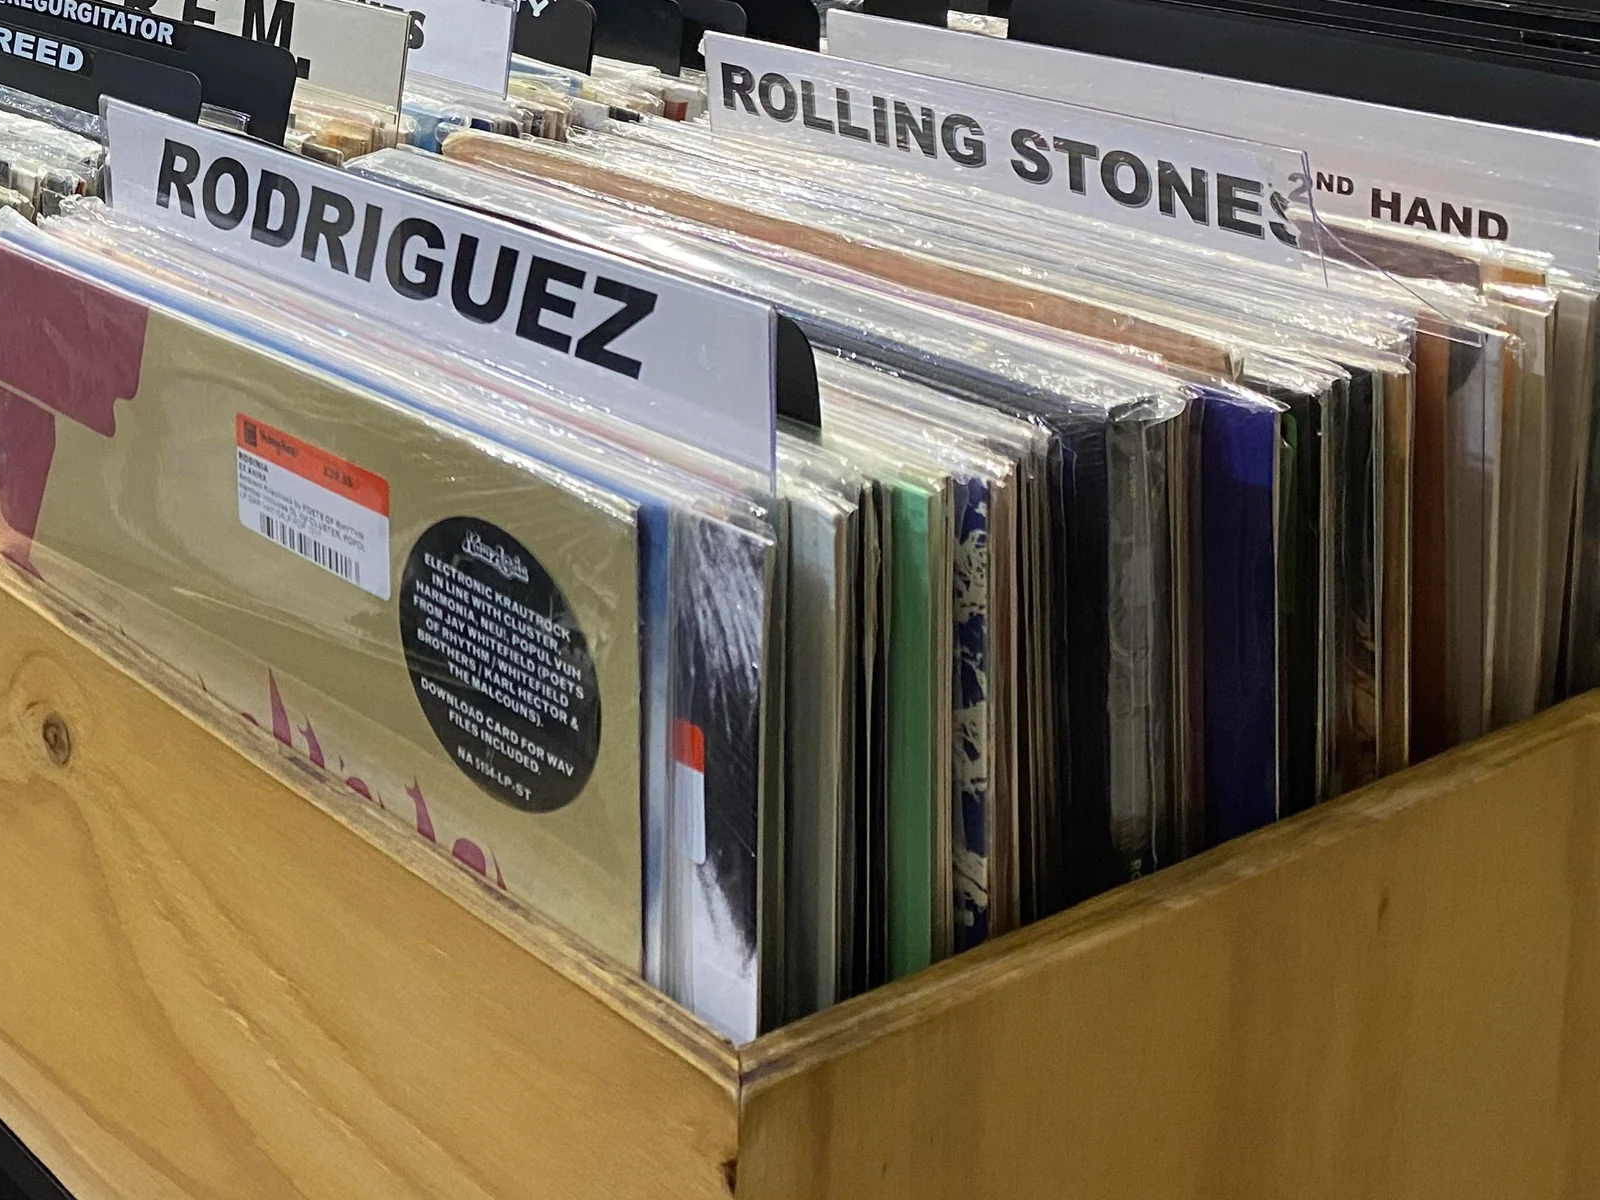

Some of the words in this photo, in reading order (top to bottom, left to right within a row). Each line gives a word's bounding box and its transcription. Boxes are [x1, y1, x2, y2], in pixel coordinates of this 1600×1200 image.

[721, 62, 987, 169] ROLLING
[1010, 129, 1300, 248] STONES
[157, 138, 658, 380] RODRIGUEZ
[1371, 188, 1509, 243] HAND
[425, 553, 493, 599] ELECTRONIC
[495, 592, 572, 642] KRAUTROCK
[432, 574, 444, 589] IN
[445, 581, 470, 604] LINE
[472, 596, 501, 621] WITH
[414, 595, 443, 620] FROM
[444, 614, 466, 636] JAY
[467, 627, 535, 673] WHITEFIELD
[537, 666, 584, 700] (POETS
[417, 628, 477, 675] BROTHERS
[484, 667, 516, 695] KARL
[518, 687, 568, 725] HECTOR
[570, 716, 579, 732] &
[425, 618, 447, 639] OF
[449, 630, 490, 663] RHYTHM
[498, 659, 569, 708] WHITEFIELD
[448, 661, 470, 684] THE
[512, 634, 551, 664] POPUL
[555, 660, 581, 680] VUH
[421, 677, 483, 724] DOWNLOAD
[486, 718, 519, 746] CARD
[521, 737, 545, 760] FOR
[546, 751, 574, 777] WAV
[449, 711, 478, 735] FILES
[458, 746, 473, 764] NA
